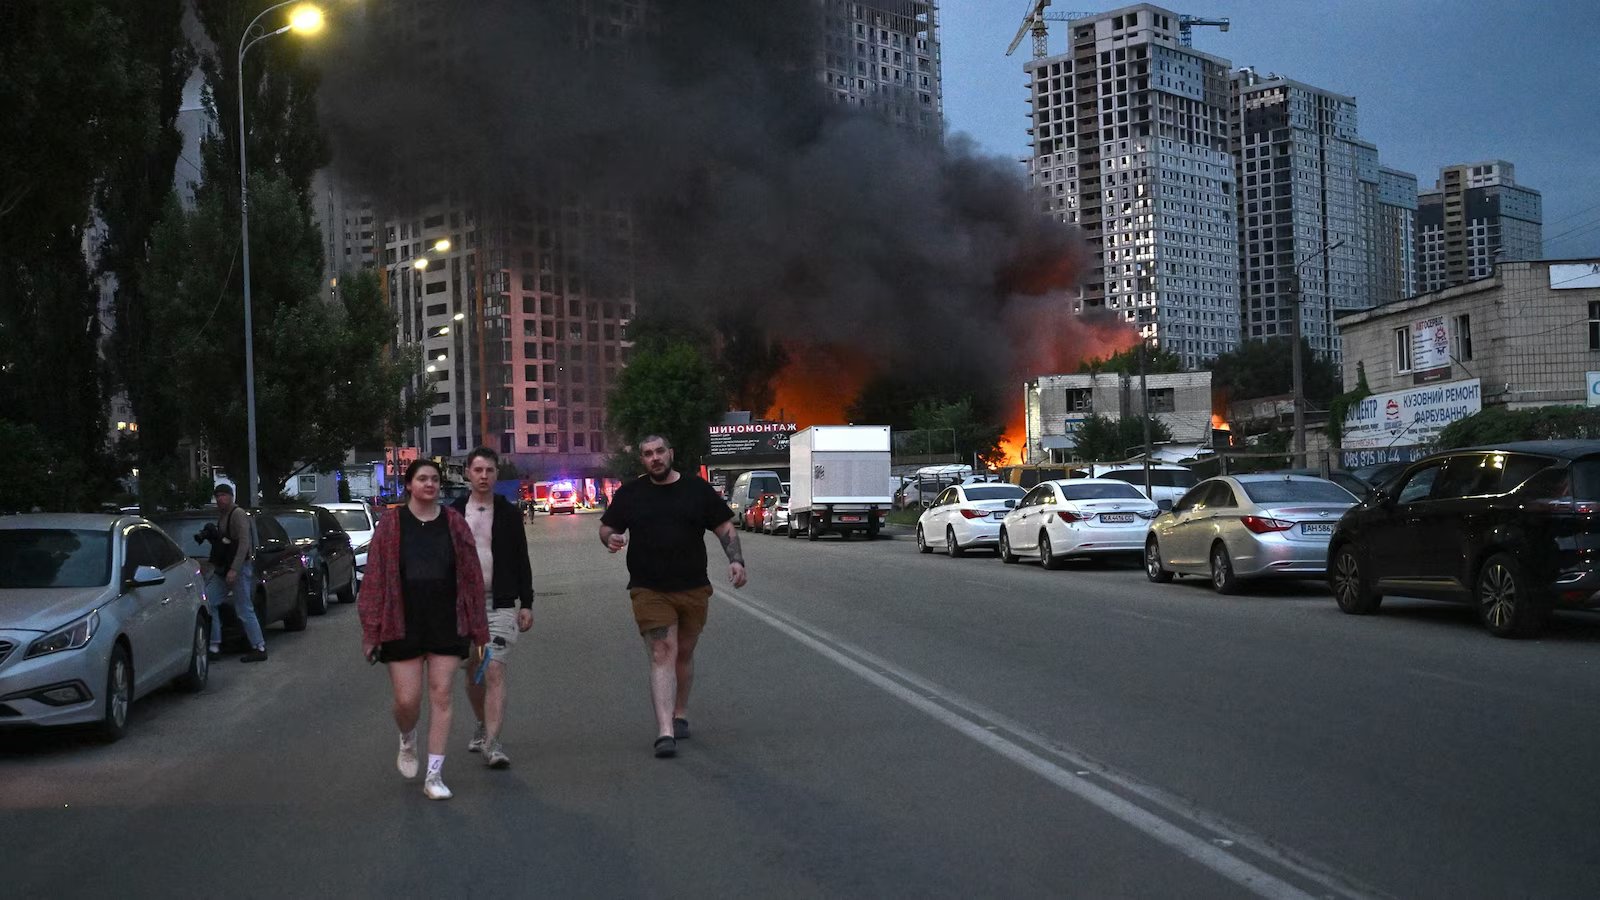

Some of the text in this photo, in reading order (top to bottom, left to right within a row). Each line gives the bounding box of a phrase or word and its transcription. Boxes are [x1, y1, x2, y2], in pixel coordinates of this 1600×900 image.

[1403, 385, 1479, 409] КУЗОВНИЙ РЕМОНТ
[1414, 405, 1467, 424] ФАРБУВАННЯ
[709, 424, 796, 434] ШИНОМОНТАЖ
